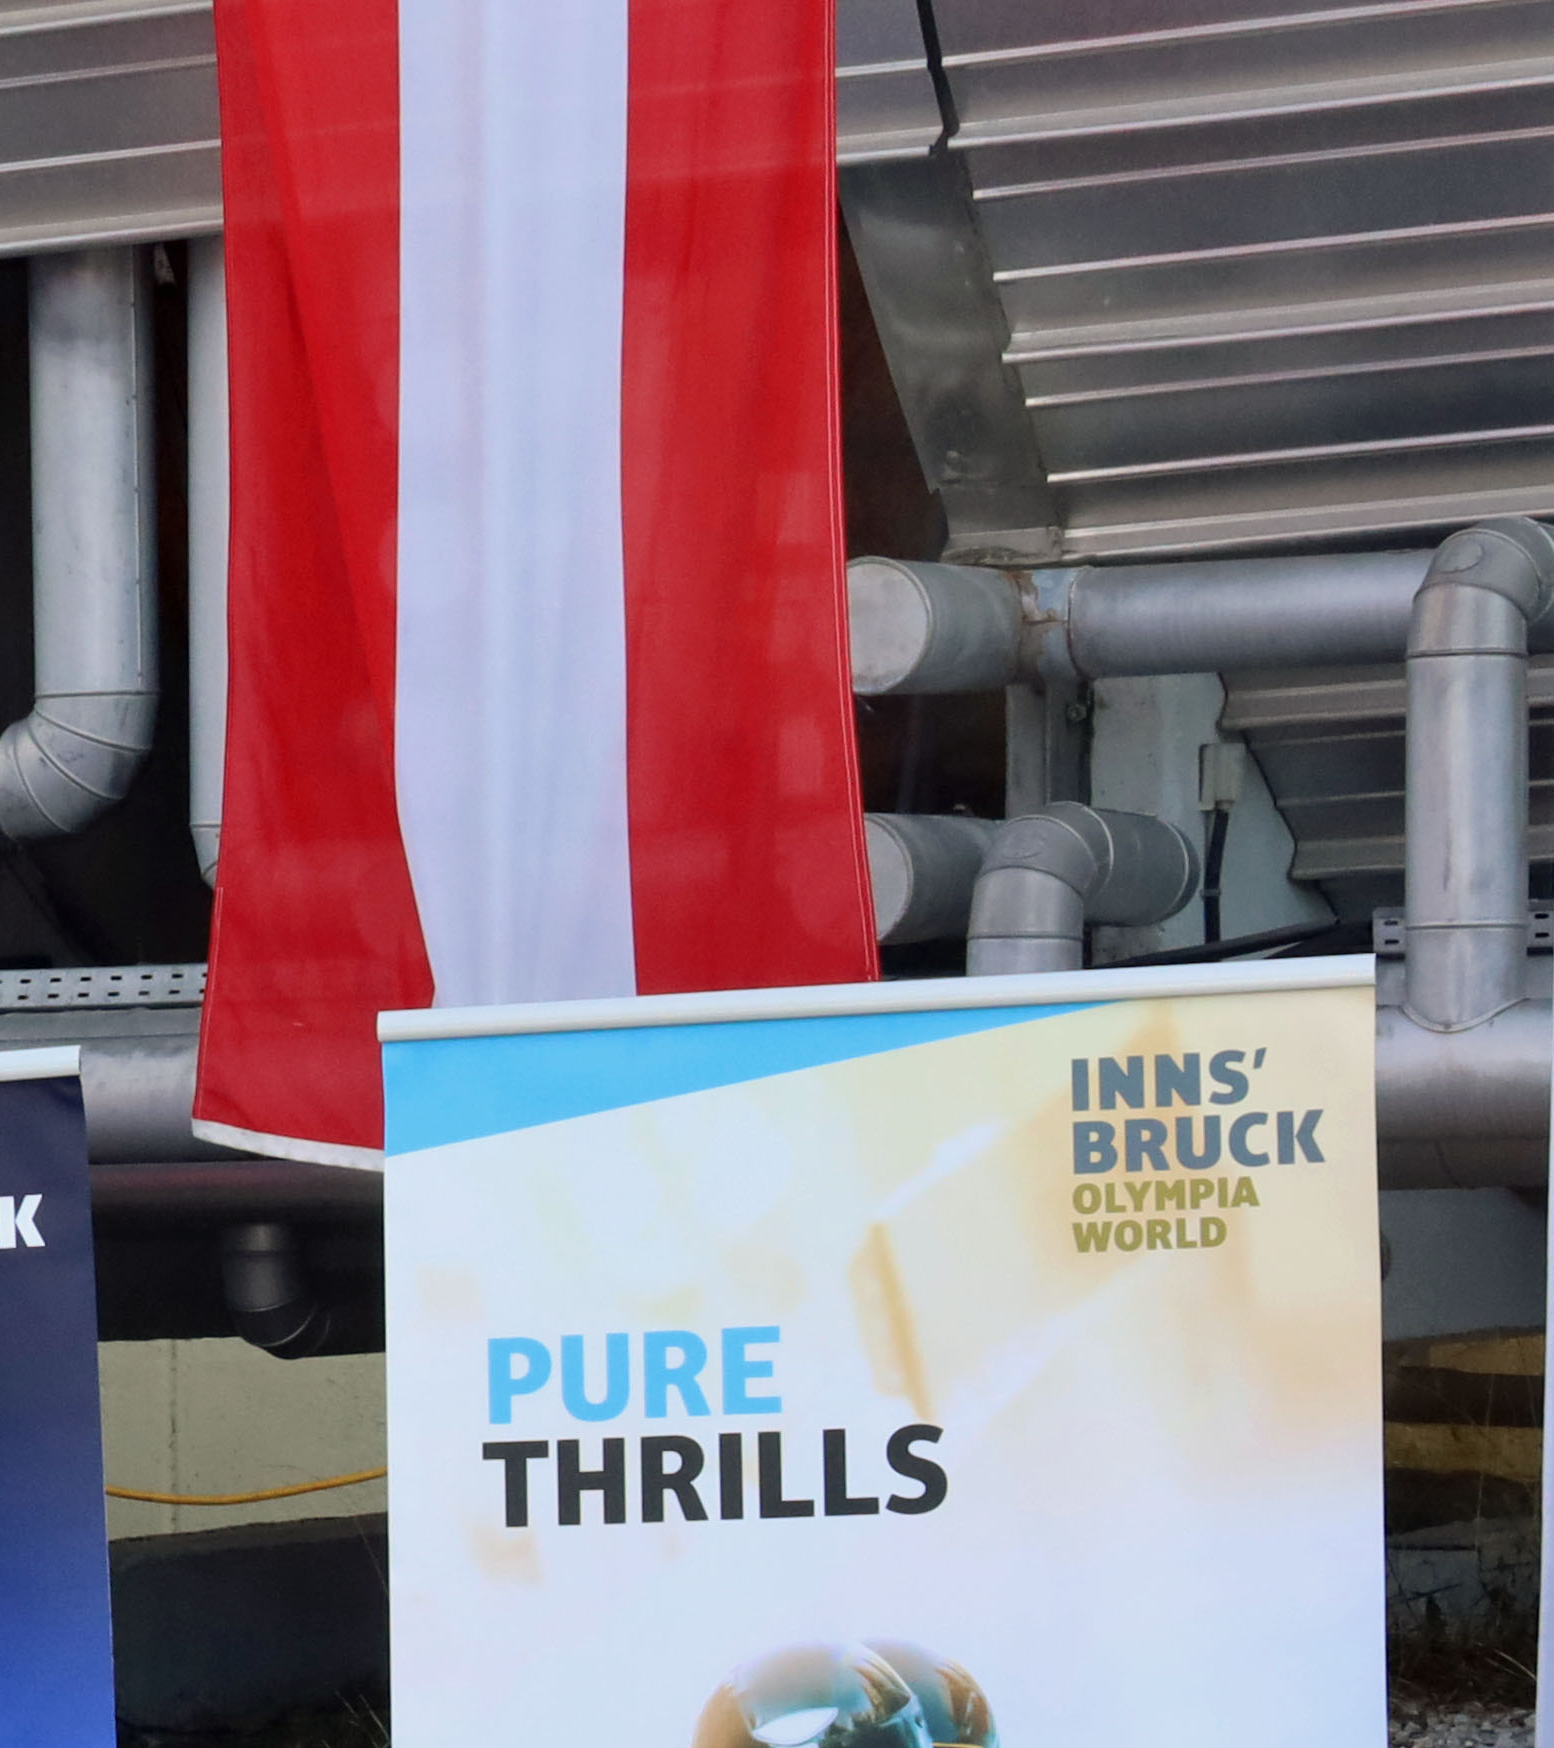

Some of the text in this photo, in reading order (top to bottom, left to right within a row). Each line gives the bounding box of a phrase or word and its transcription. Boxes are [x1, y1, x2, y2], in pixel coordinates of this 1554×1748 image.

[1072, 1108, 1325, 1175] BRUCK
[1072, 1177, 1260, 1215] OLYMPIA
[1072, 1216, 1227, 1253] WORLD
[487, 1325, 784, 1425] PURE
[482, 1424, 948, 1528] THRILLS
